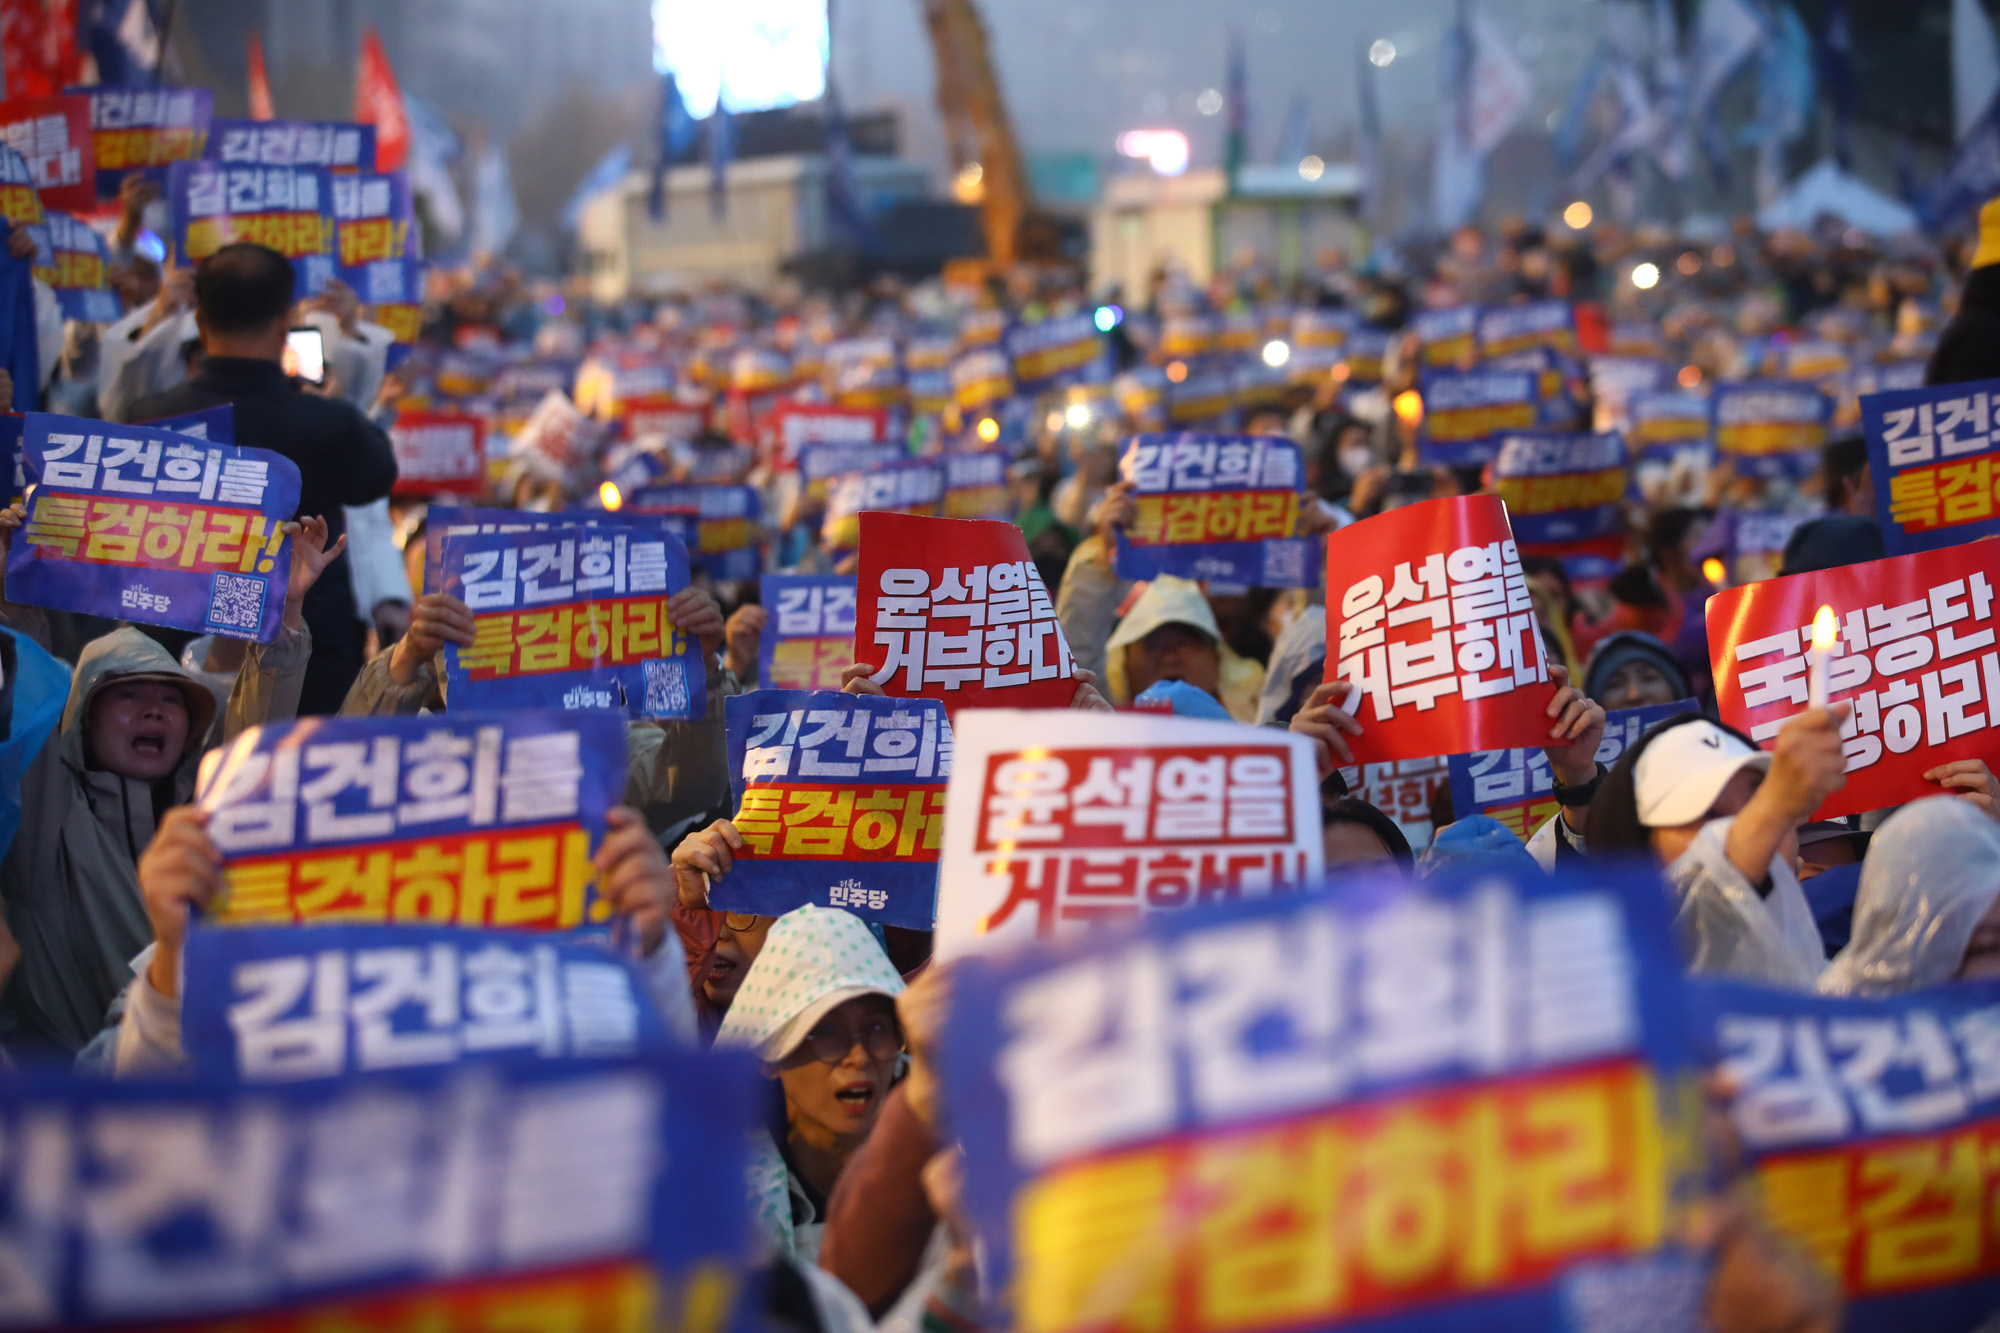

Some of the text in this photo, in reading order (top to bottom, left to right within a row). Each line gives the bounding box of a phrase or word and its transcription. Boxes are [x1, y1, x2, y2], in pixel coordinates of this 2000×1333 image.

[187, 168, 320, 217] 김건희를
[1133, 441, 1298, 491] 김건희를
[1882, 392, 2000, 467] 김건
[42, 433, 269, 505] 김건희를
[1889, 458, 2000, 526] 특검
[26, 496, 287, 573] 특검하라!
[461, 534, 668, 609] 김건희를
[122, 589, 172, 613] 민주당
[876, 561, 1057, 628] 윤석열을
[1339, 539, 1533, 660] 윤석열을
[1337, 611, 1553, 722] 거부한다
[1735, 570, 1996, 709] 국정농단
[1750, 651, 2000, 774] 명하라
[206, 727, 584, 851] 김건희를
[986, 753, 1288, 843] 윤석열을
[829, 886, 889, 910] 민주당
[228, 944, 640, 1084] 김건희를
[1000, 890, 1638, 1164] 김건희를
[1750, 1132, 2000, 1288] 특검
